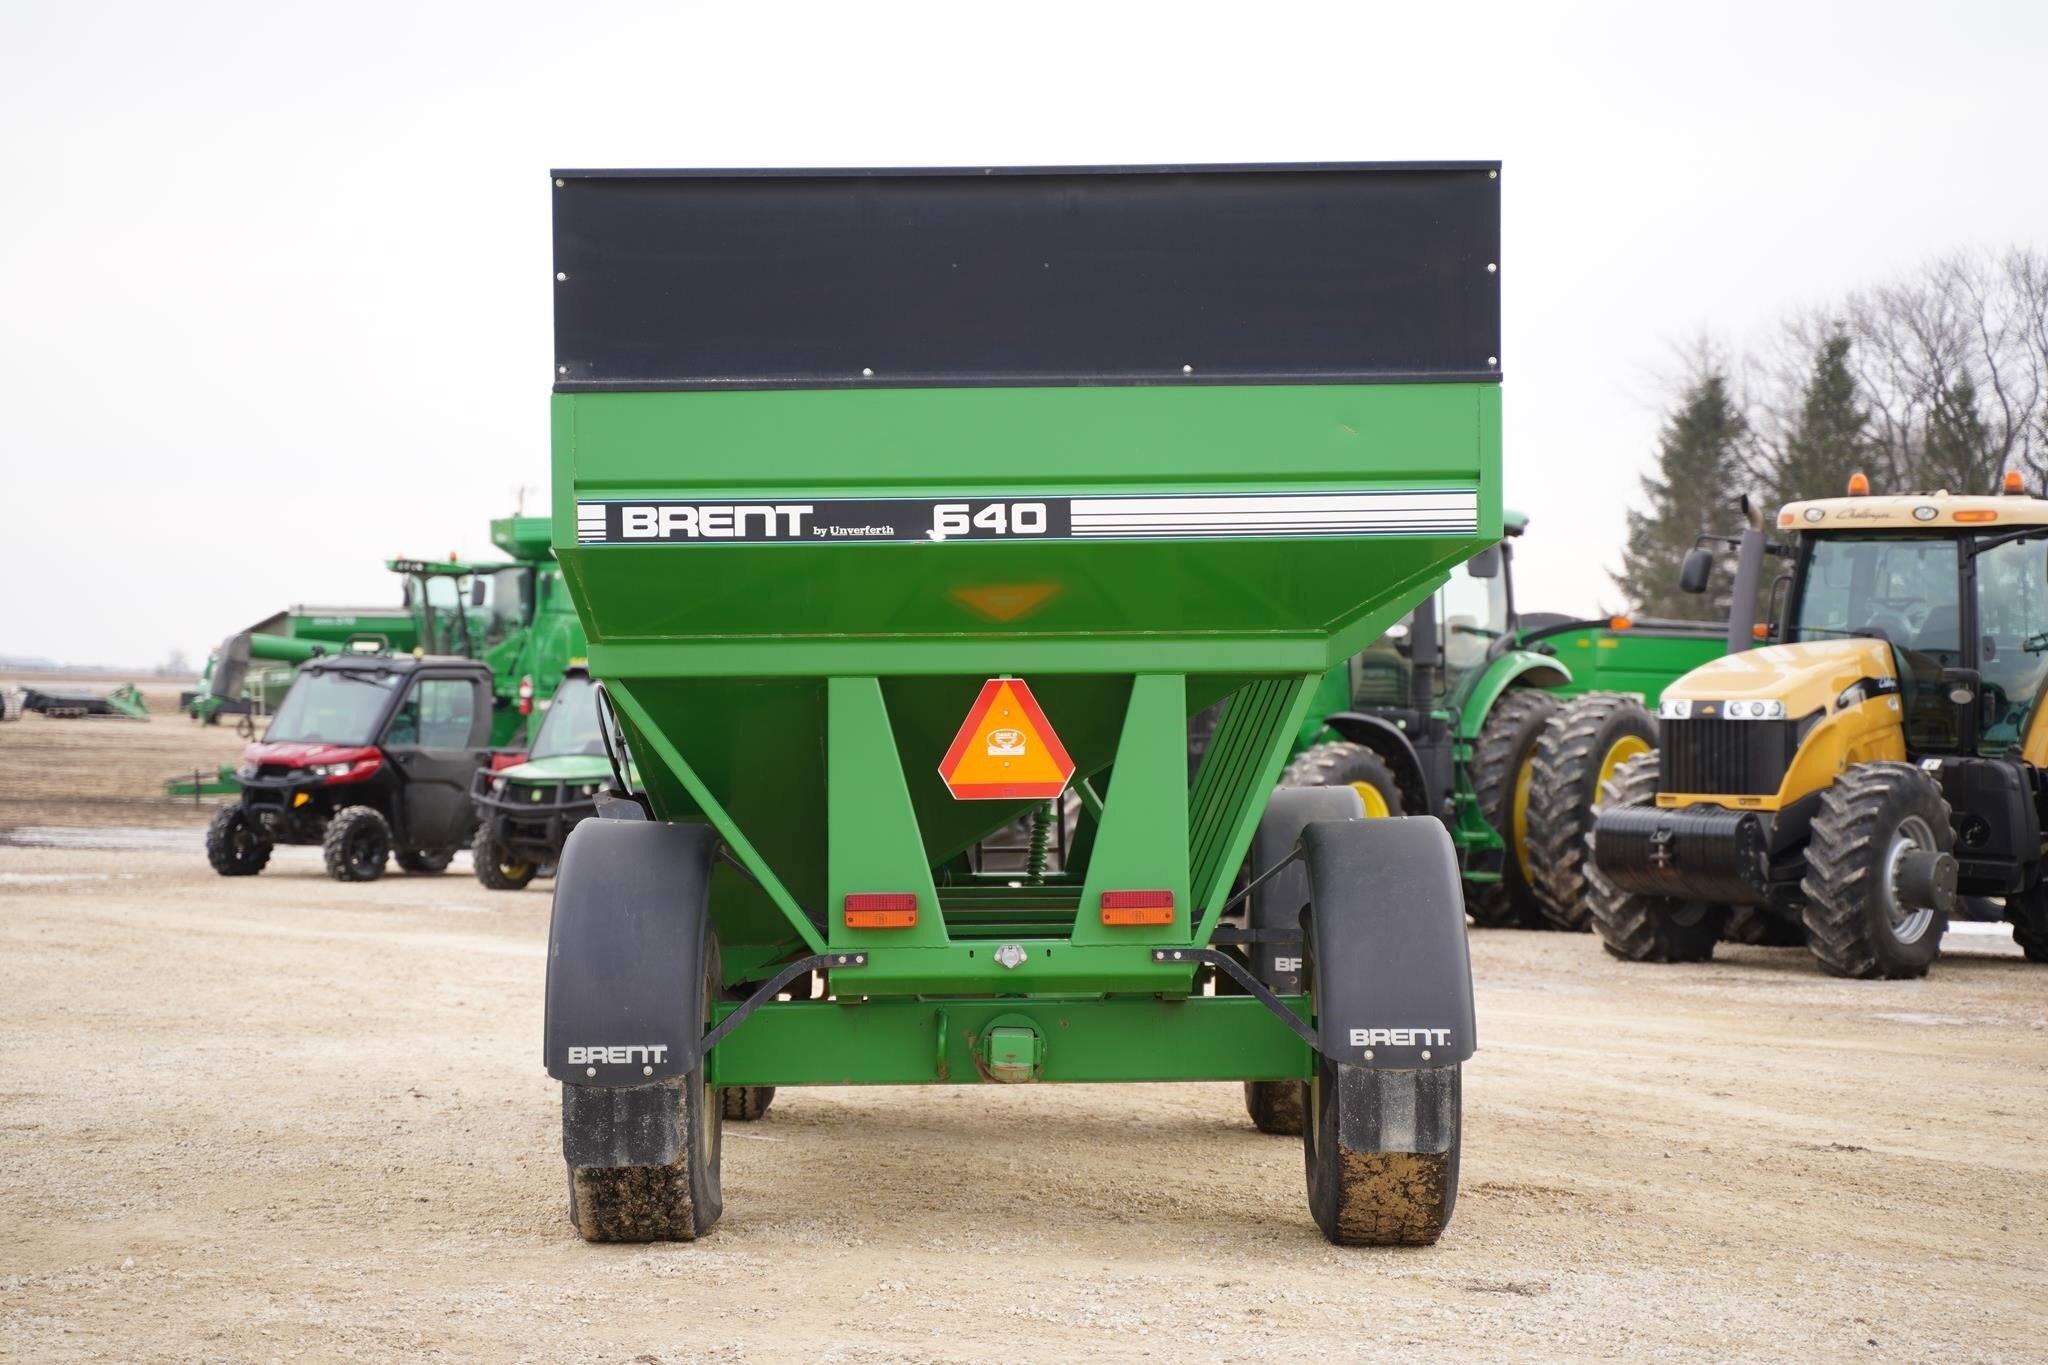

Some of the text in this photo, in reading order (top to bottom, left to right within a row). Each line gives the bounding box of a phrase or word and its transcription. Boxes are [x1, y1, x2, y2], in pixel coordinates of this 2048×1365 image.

[622, 502, 1047, 538] BRENT by Unverferth 640
